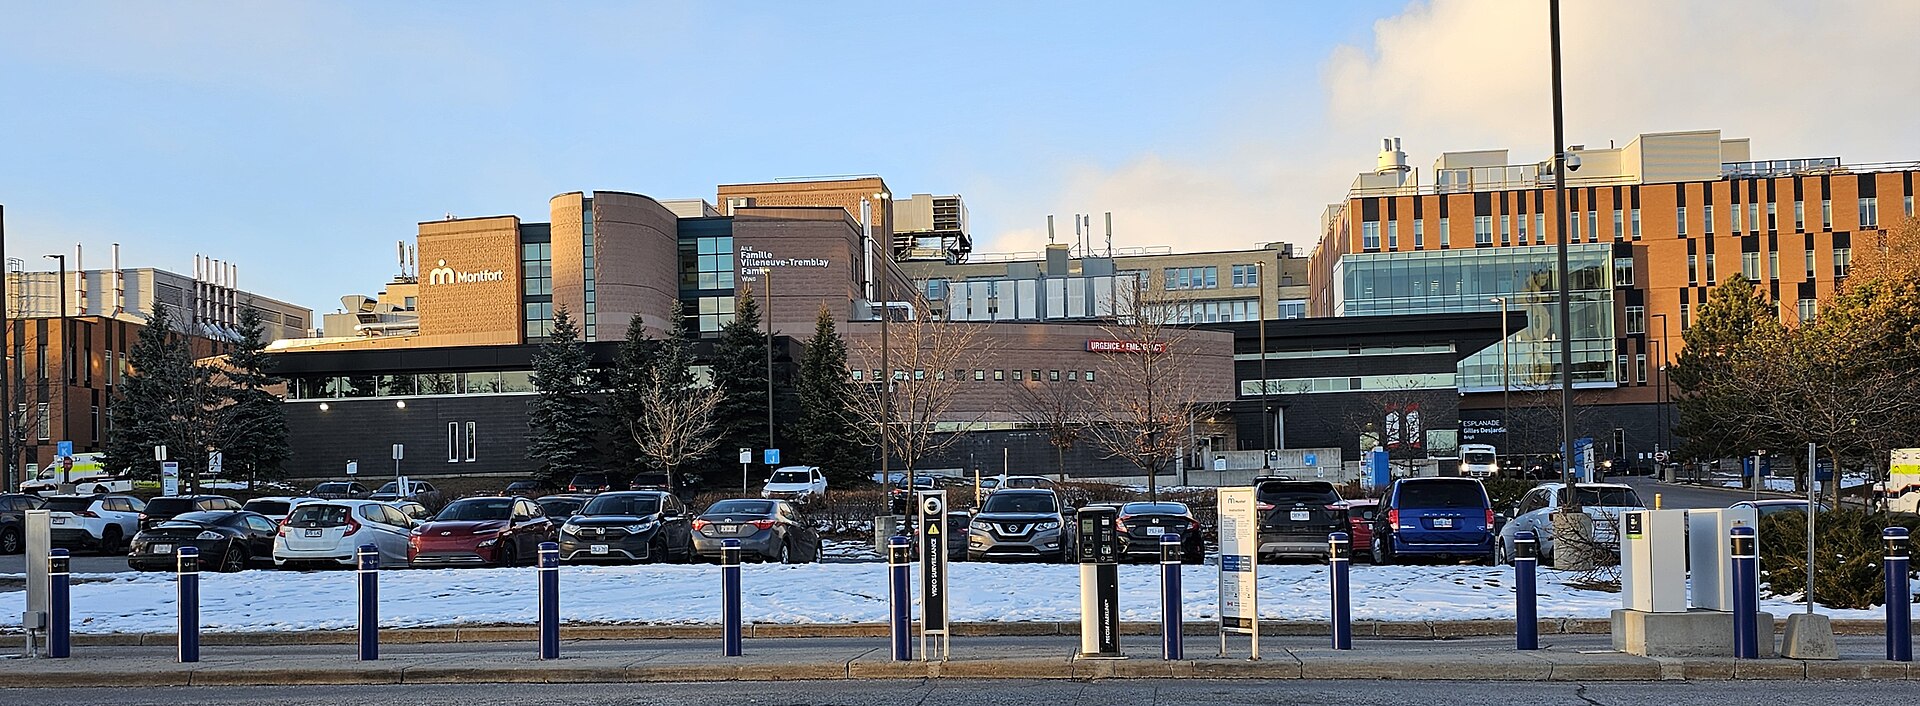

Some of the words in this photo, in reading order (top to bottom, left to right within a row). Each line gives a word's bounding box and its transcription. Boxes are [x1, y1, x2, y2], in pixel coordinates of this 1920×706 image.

[740, 251, 773, 259] Famille
[740, 258, 829, 268] Villeneuve-Tremblay
[457, 269, 503, 283] Montfort
[1091, 341, 1120, 350] URGENCE
